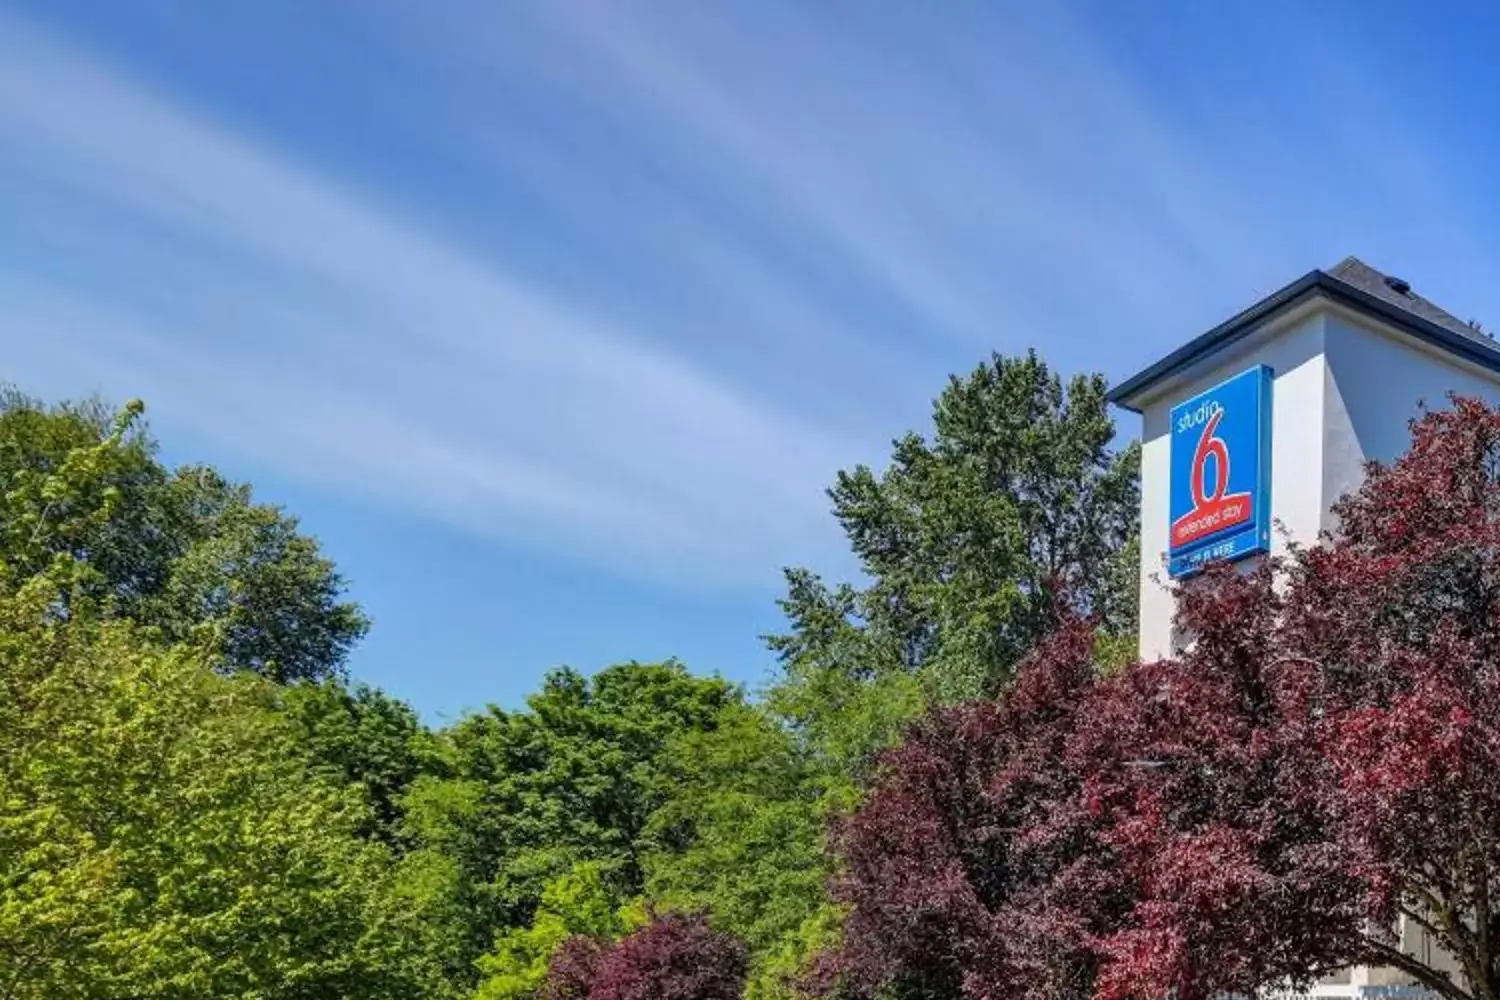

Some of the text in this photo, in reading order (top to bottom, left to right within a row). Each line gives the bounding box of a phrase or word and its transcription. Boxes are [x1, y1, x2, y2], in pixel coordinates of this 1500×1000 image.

[1177, 399, 1219, 433] studio
[1190, 407, 1230, 506] 6
[1222, 502, 1243, 521] stay
